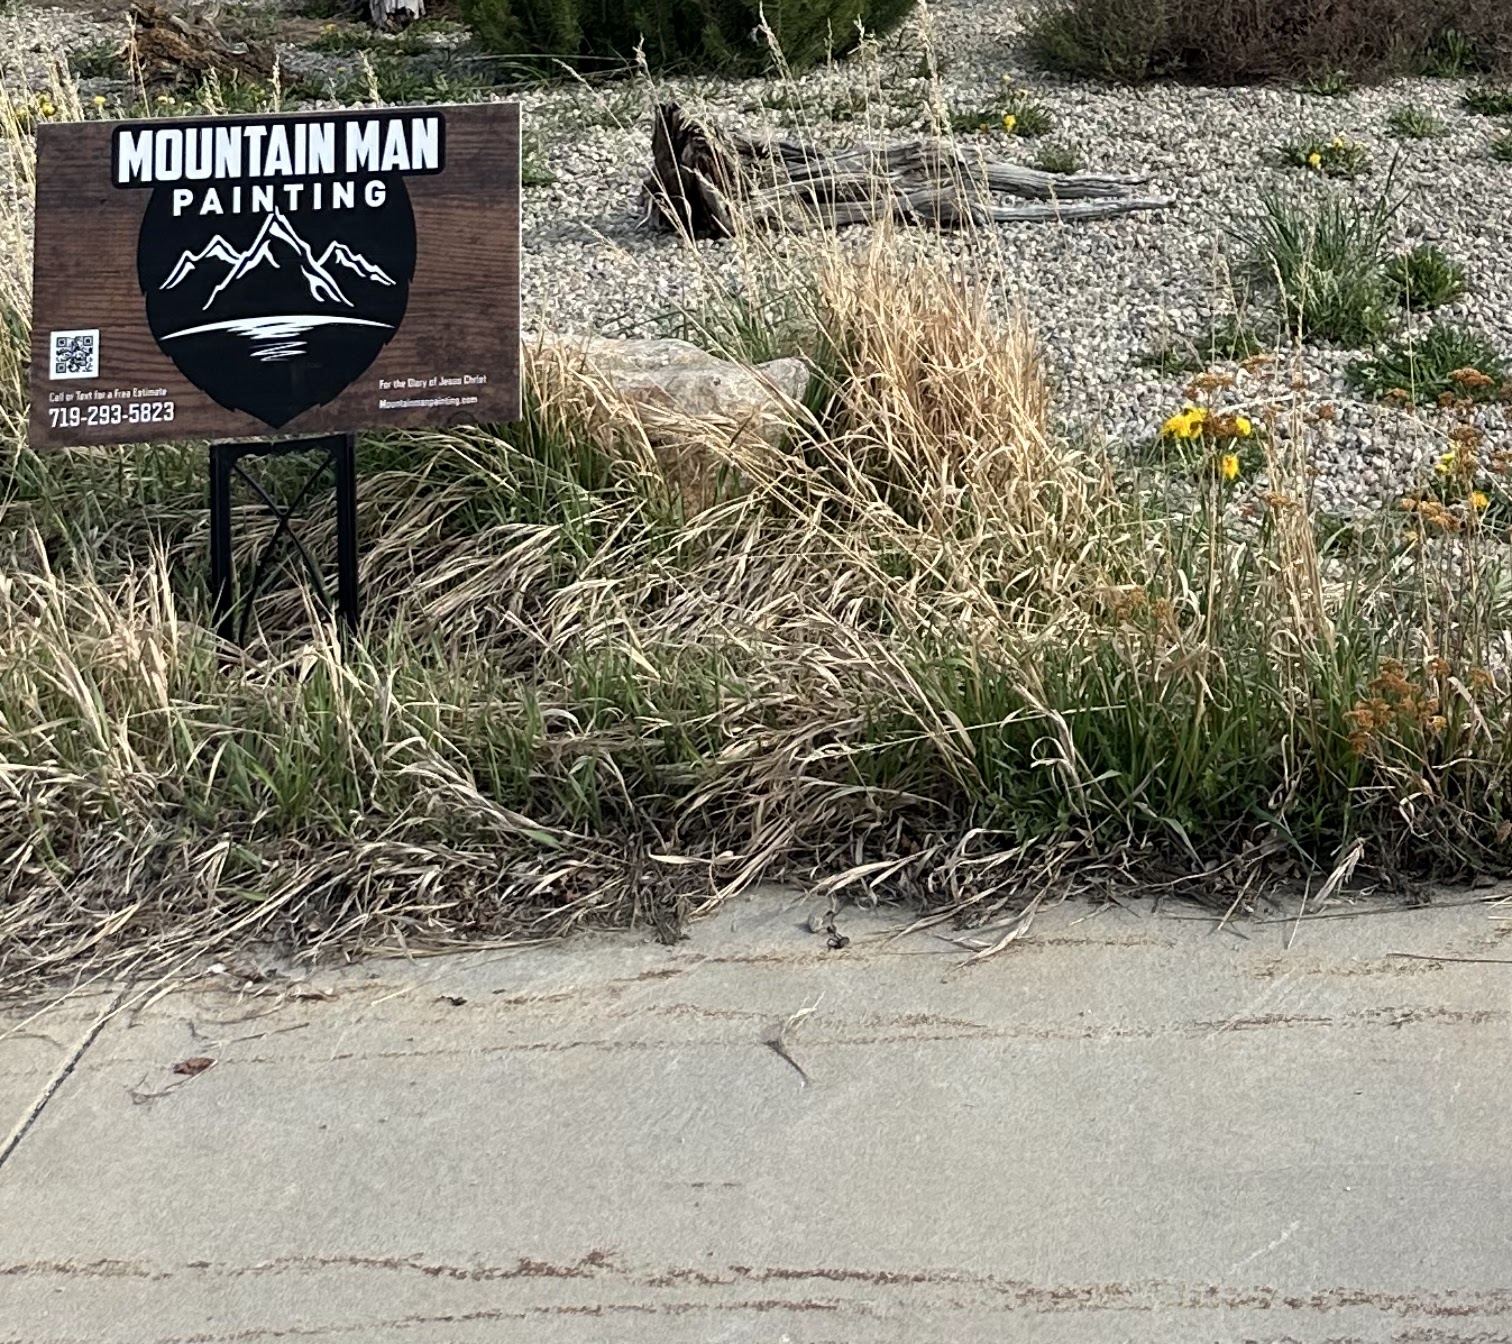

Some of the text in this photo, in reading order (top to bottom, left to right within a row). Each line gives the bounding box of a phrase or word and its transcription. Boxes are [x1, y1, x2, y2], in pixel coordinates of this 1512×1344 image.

[118, 117, 439, 183] MOUNTAIN MAN
[173, 179, 387, 217] PAINTING
[49, 387, 168, 402] Call or Text for a Free Estimate
[379, 379, 392, 390] For
[393, 378, 406, 389] the
[429, 376, 438, 387] of
[463, 374, 488, 385] Christ
[48, 401, 175, 428] 719-293-5823
